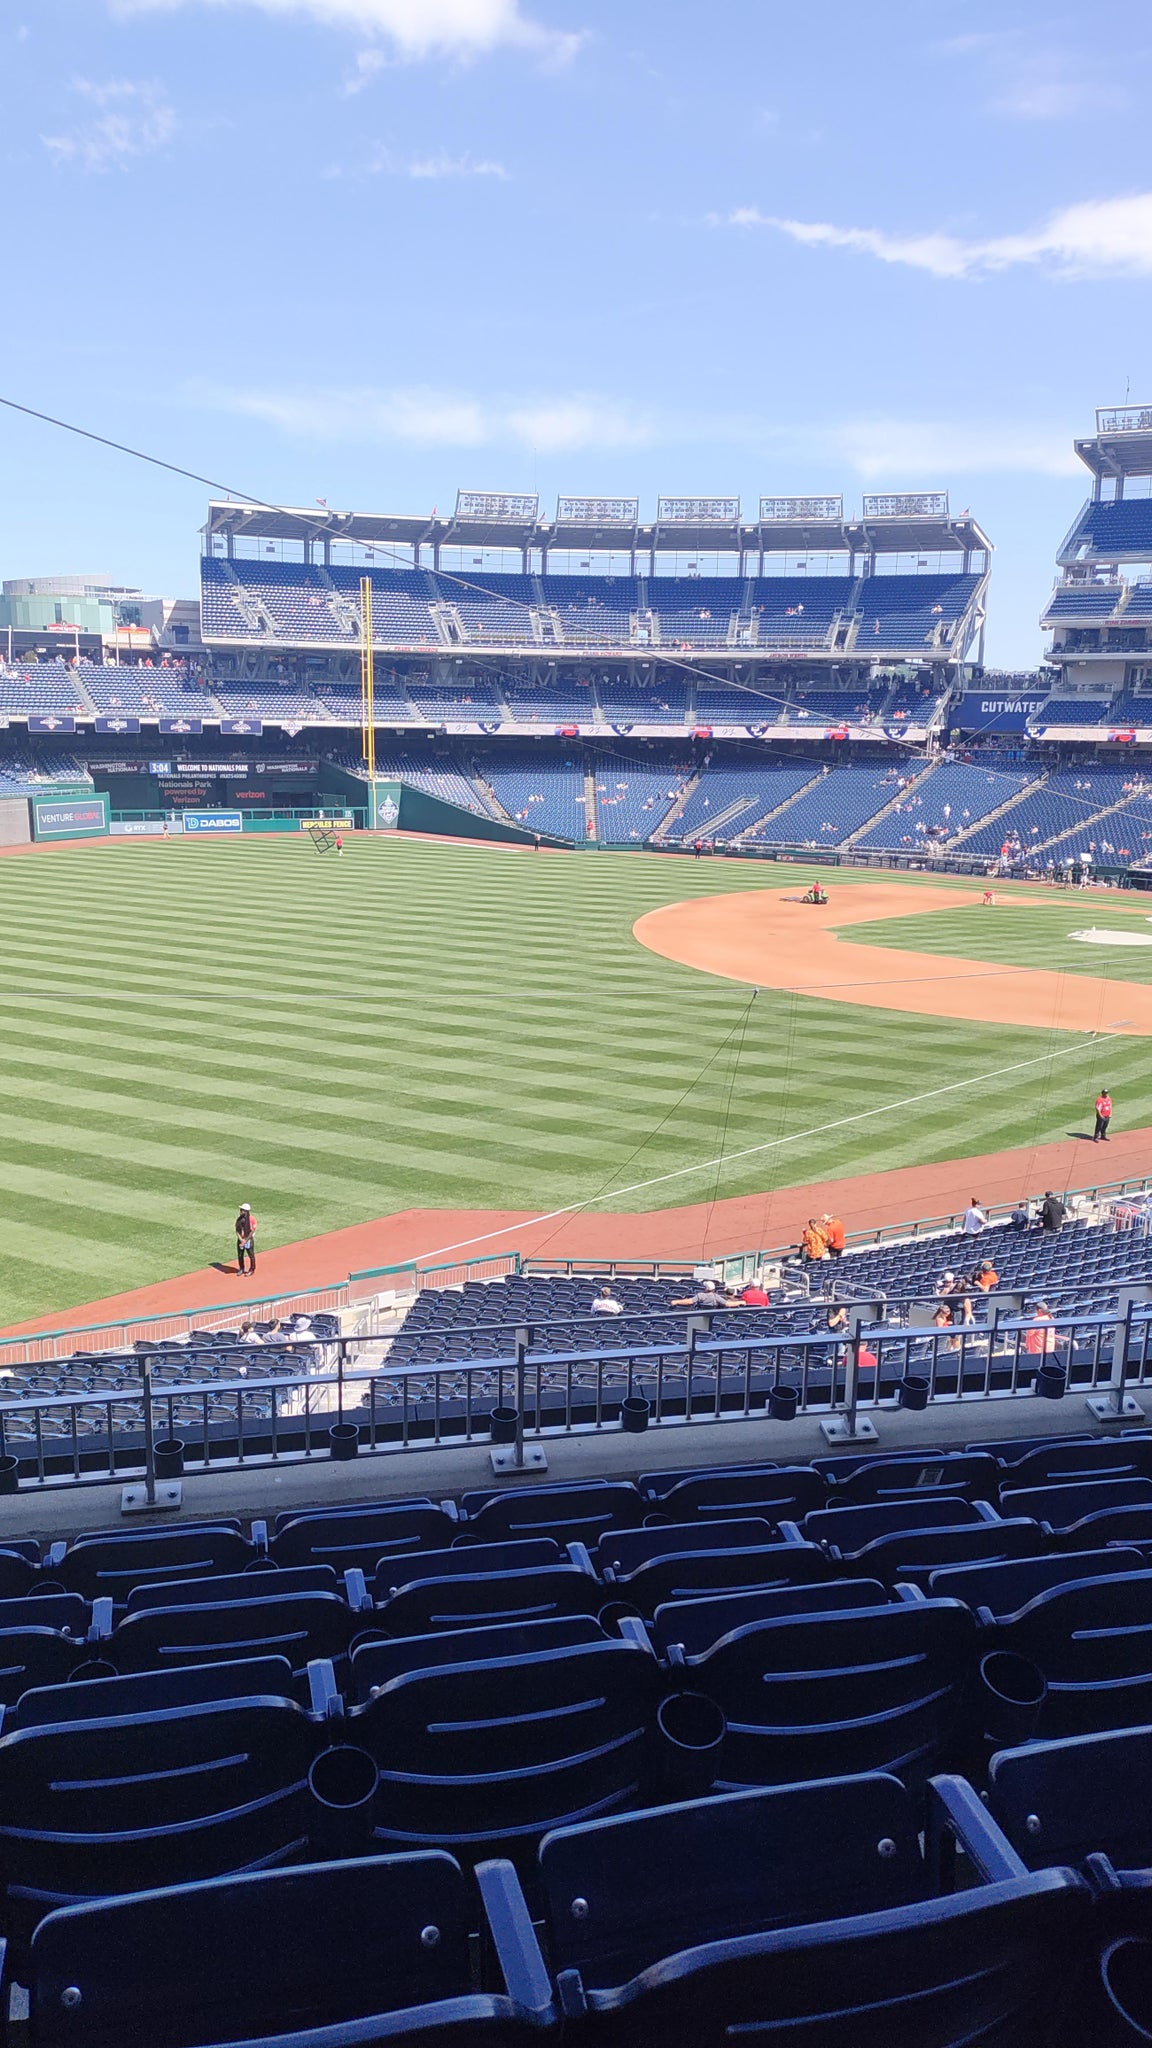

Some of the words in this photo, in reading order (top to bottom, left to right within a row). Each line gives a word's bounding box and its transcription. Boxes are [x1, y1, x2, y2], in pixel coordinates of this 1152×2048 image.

[89, 762, 126, 770] WASHINGTON
[151, 764, 168, 773] 3:04
[177, 764, 200, 772] WELCOME
[201, 764, 207, 772] TO
[208, 764, 234, 772] NATIONALS
[235, 764, 249, 772] PARK
[158, 781, 193, 789] Nationals
[194, 781, 212, 789] Park
[164, 789, 195, 797] powered
[196, 789, 207, 797] by
[235, 790, 265, 799] verizon
[41, 813, 75, 824] VENTURE
[74, 811, 101, 821] GLOBAL
[200, 819, 240, 828] DABOS
[332, 820, 352, 829] FENCE
